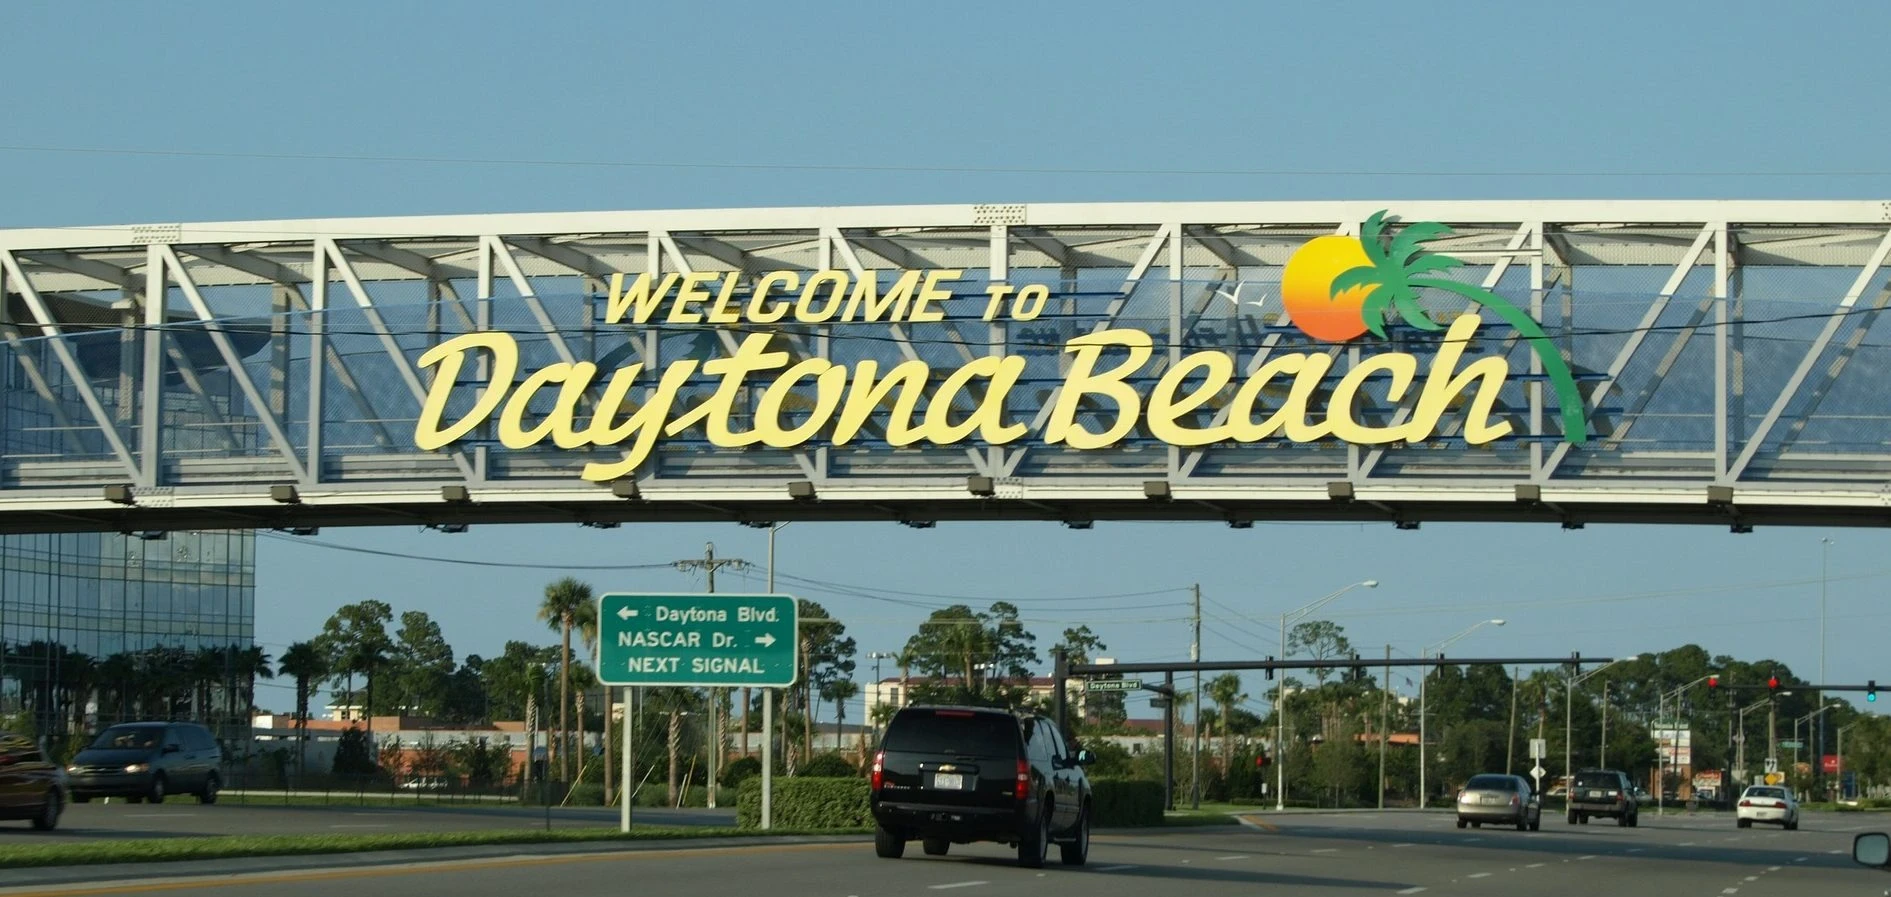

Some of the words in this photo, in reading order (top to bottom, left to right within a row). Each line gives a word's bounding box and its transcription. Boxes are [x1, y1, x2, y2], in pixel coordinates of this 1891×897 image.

[605, 269, 966, 325] WELCOME
[983, 284, 1050, 322] TO
[414, 331, 1028, 482] Daytona
[1044, 313, 1513, 450] Beach
[655, 605, 727, 625] Daytona
[737, 606, 780, 622] Blvd.
[618, 631, 701, 648] NASCAR
[712, 632, 738, 648] Dr.
[628, 657, 680, 673] NEXT
[691, 657, 765, 674] SIGNAL
[1121, 681, 1138, 689] Blvd
